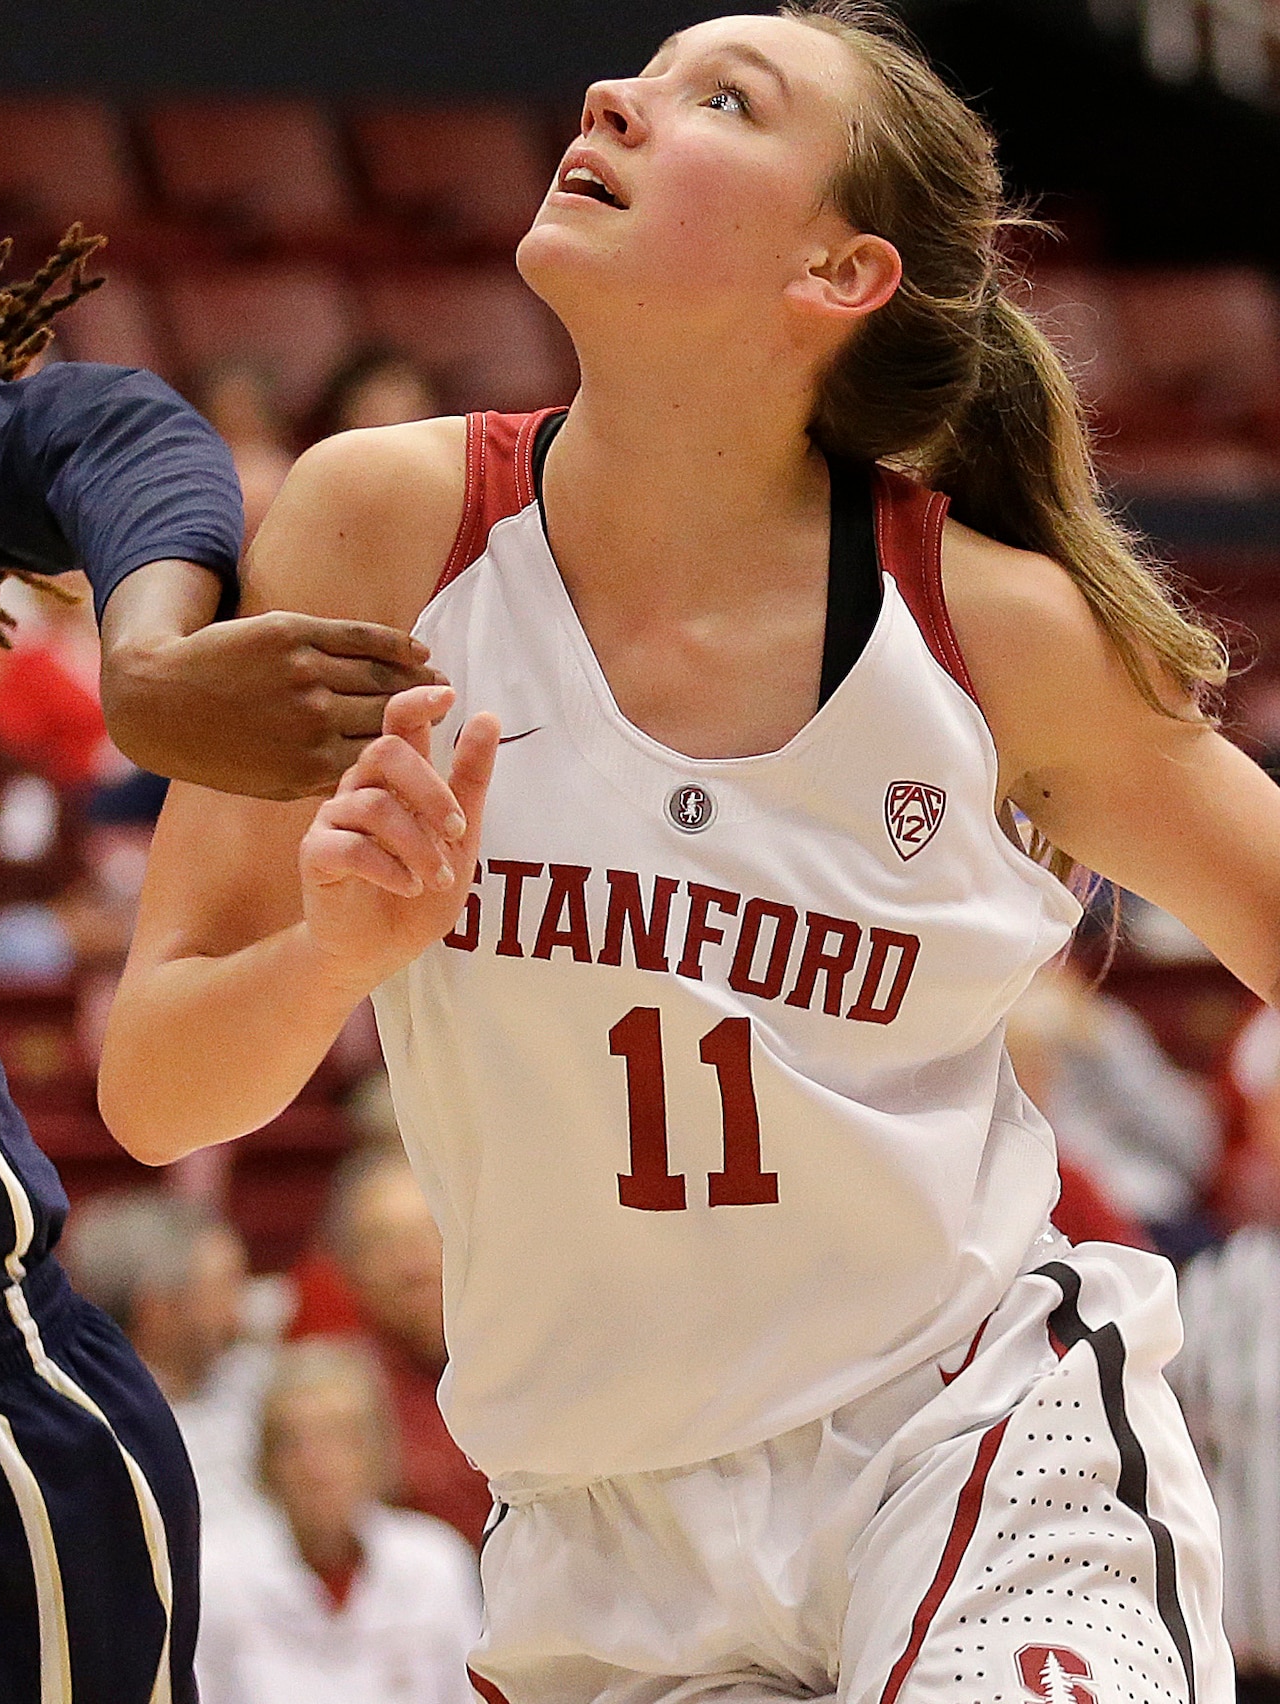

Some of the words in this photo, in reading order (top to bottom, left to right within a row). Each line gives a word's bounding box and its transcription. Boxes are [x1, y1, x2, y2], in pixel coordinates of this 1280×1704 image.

[890, 785, 942, 831] PAC
[895, 814, 925, 843] 12
[442, 857, 921, 1026] STANFORD
[609, 1006, 780, 1211] 11
